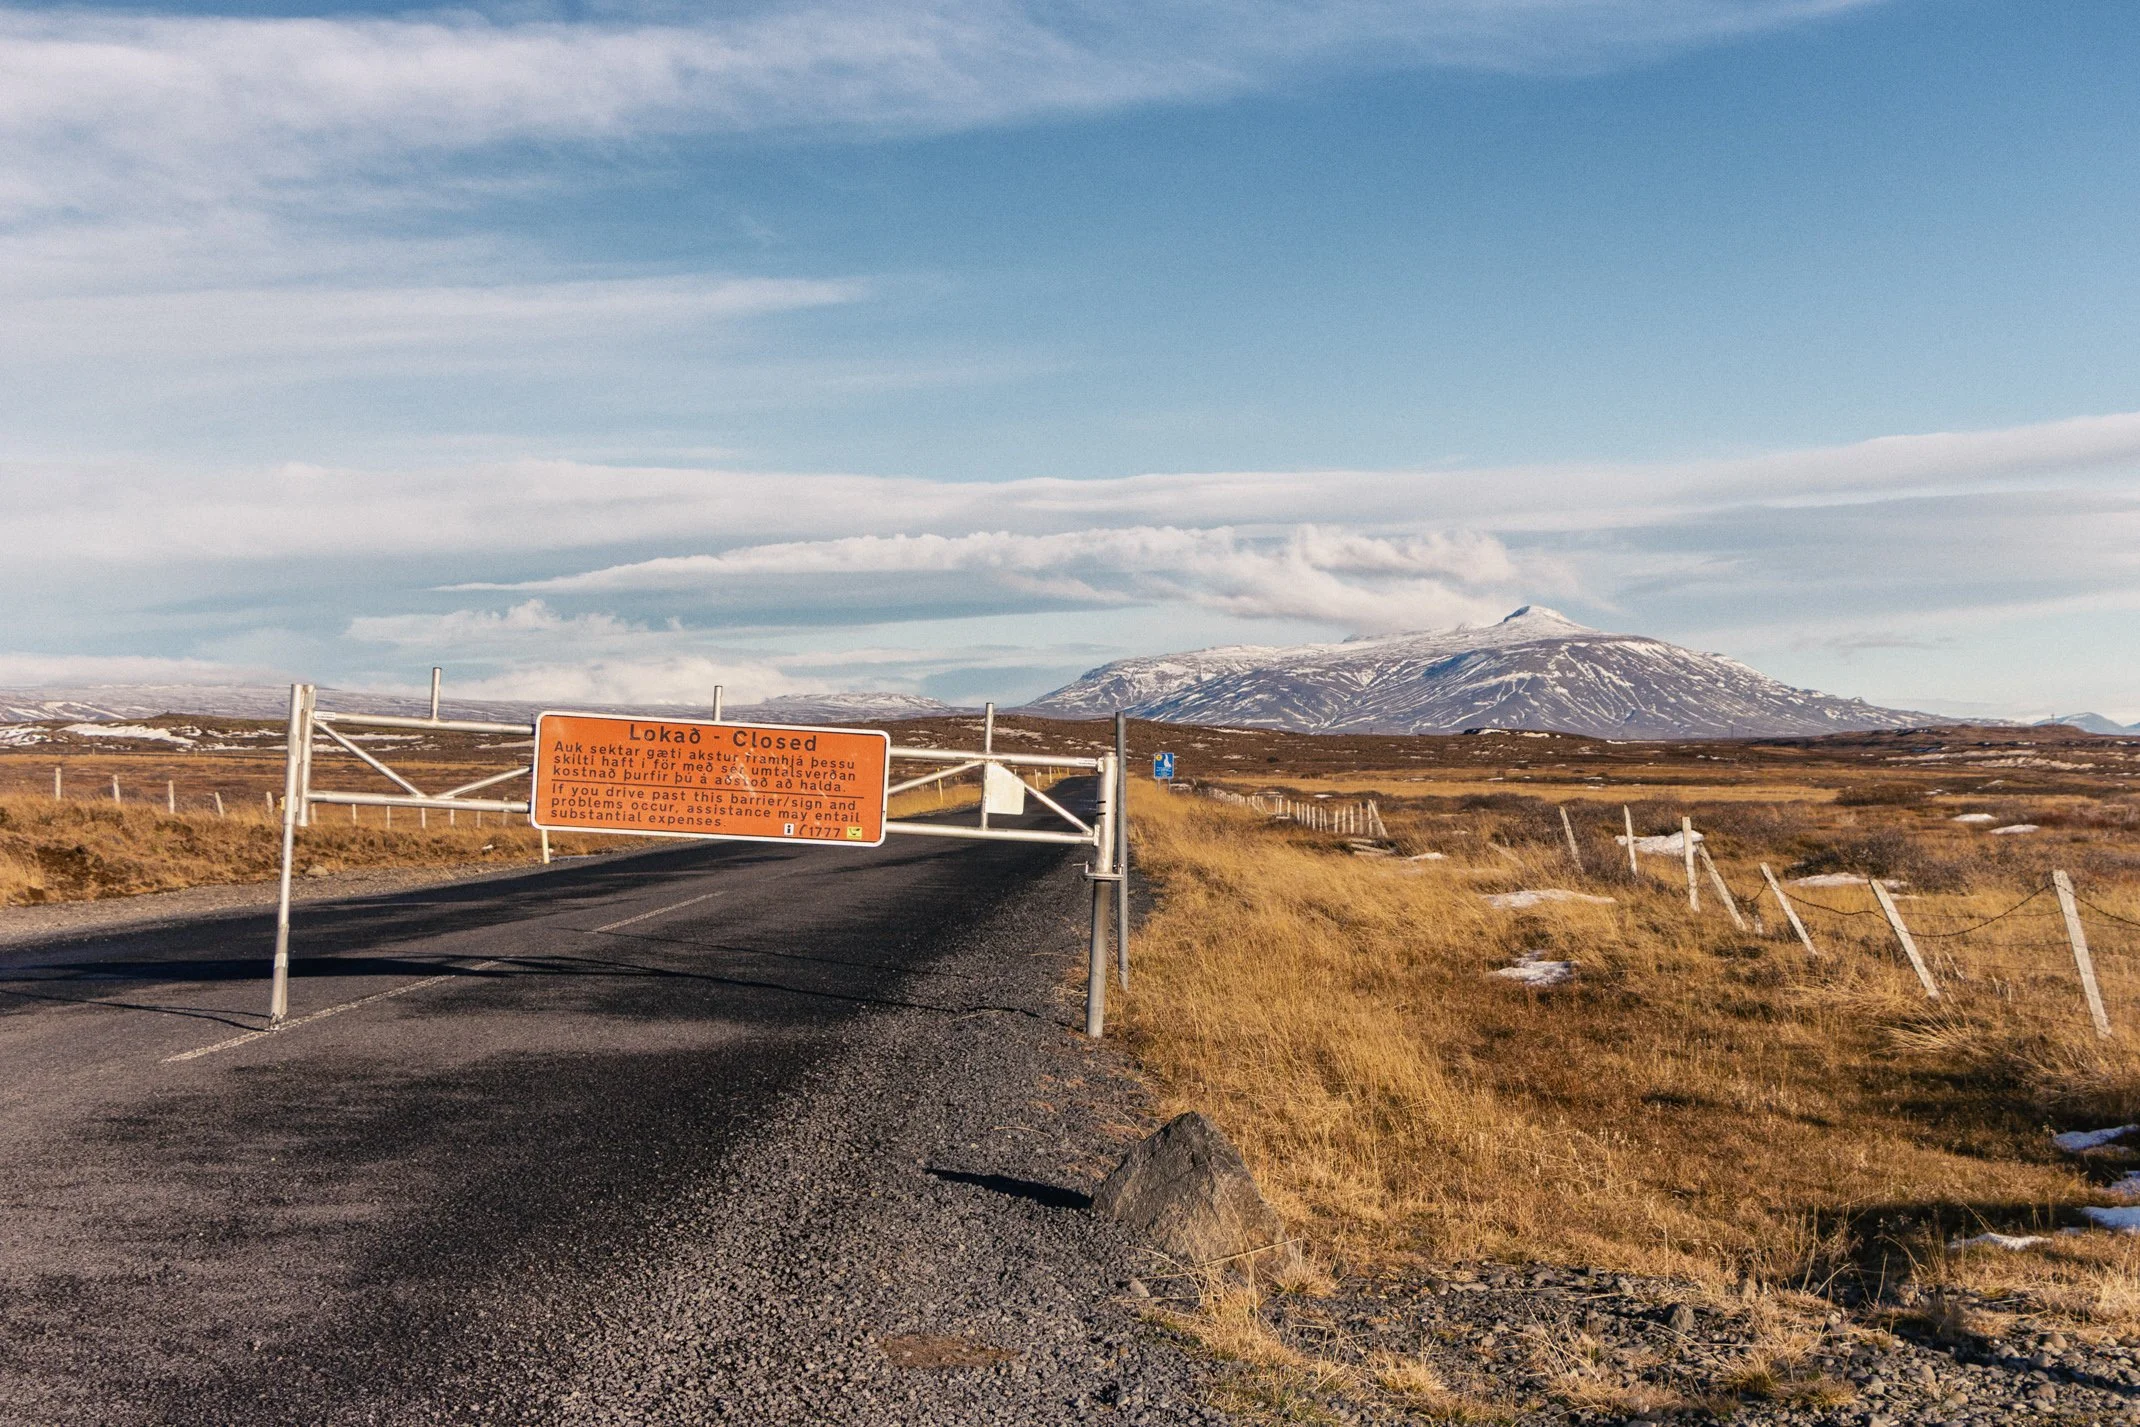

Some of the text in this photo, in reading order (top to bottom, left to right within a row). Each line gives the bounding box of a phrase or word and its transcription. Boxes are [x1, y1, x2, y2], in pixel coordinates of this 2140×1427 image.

[629, 723, 701, 744] Lokað
[733, 730, 817, 751] Closed
[554, 741, 855, 769] Auk sektar gæti akstur framhjá þessu
[554, 754, 594, 765] skilti
[602, 756, 634, 768] haft
[653, 759, 676, 770] för
[683, 762, 713, 772] með
[721, 763, 744, 774] sér
[751, 766, 856, 781] umtalsverðan
[553, 765, 616, 779] kostnað
[624, 769, 668, 781] þurfir
[675, 772, 692, 784] þú
[700, 772, 707, 784] á
[776, 778, 793, 789] að
[800, 780, 846, 793] halda.
[551, 796, 623, 809] problems
[687, 804, 771, 818] assistance
[778, 810, 807, 821] may
[815, 811, 860, 822] entail
[552, 783, 856, 811] If you drive past this barrier/sign and
[551, 808, 726, 827] substantial expenses.
[809, 826, 841, 838] 1777
